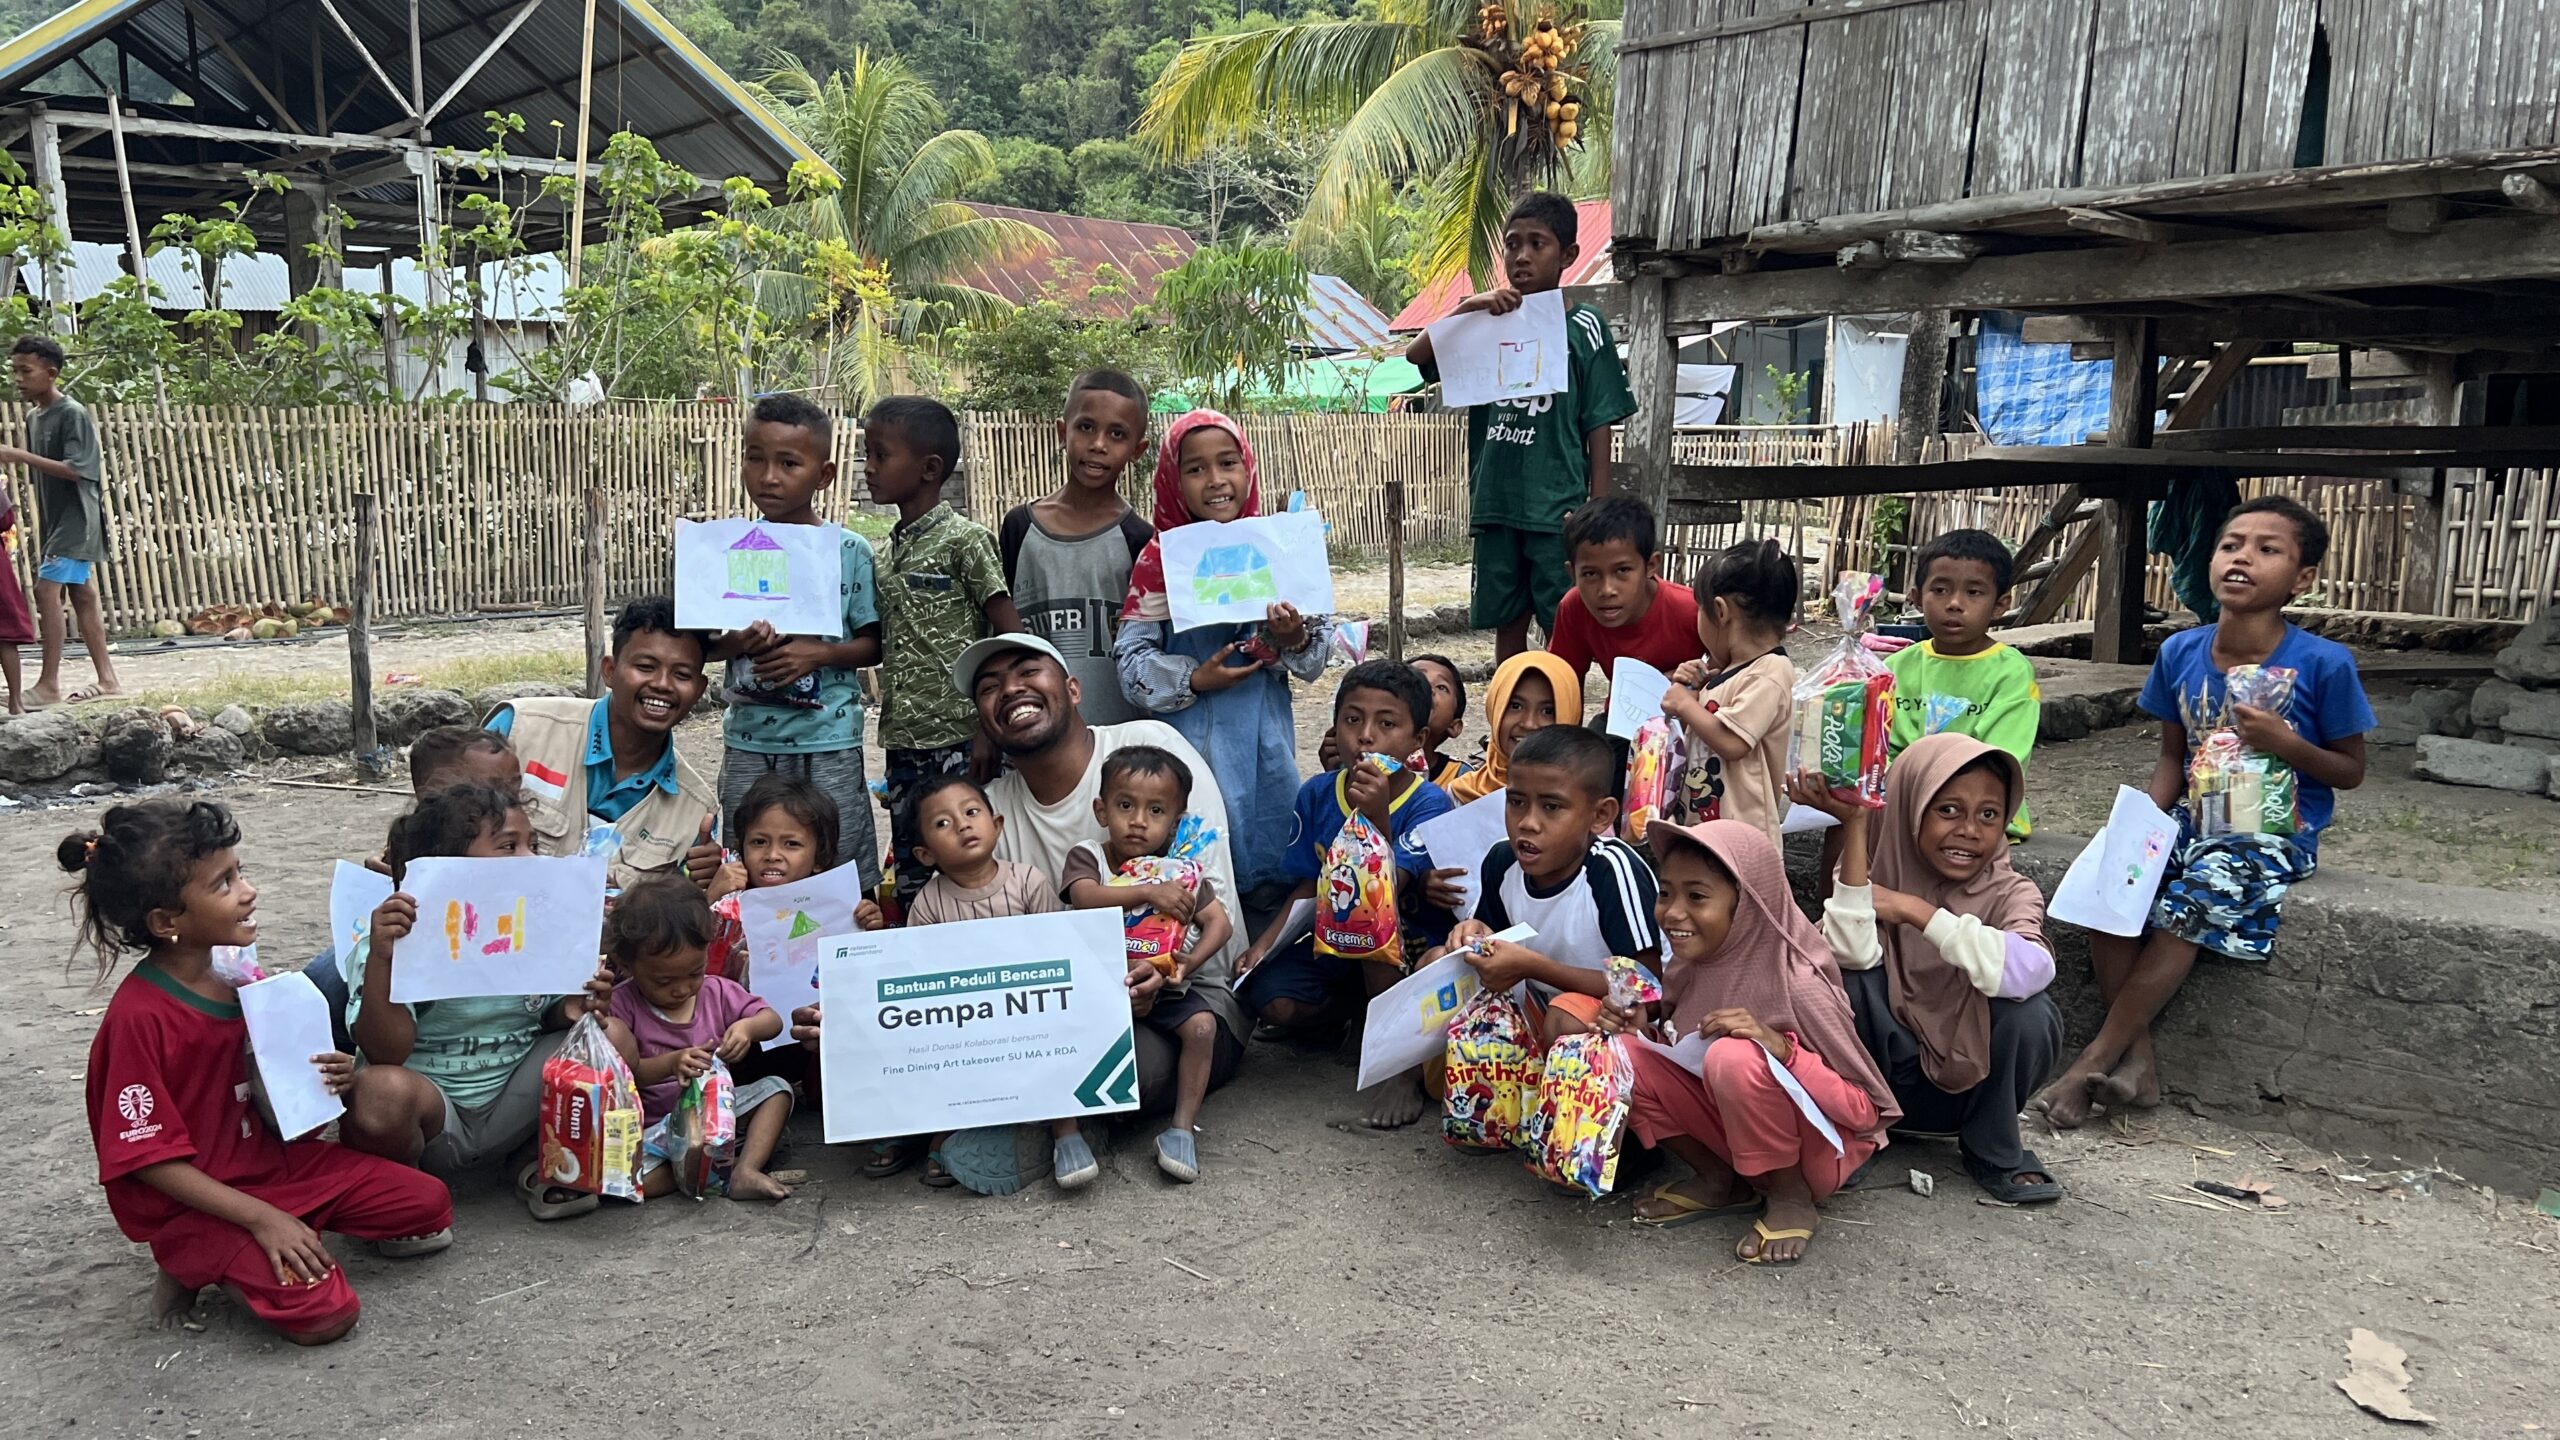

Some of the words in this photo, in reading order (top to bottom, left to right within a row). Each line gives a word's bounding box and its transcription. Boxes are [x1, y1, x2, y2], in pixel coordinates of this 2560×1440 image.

[1497, 412, 1519, 422] VISIT
[1487, 422, 1537, 446] etroit
[1868, 764, 1880, 792] Roma
[884, 980, 946, 996] Bantuan
[950, 971, 996, 989] Peduli
[1000, 967, 1065, 983] Bencana
[878, 1001, 994, 1030] Gempa
[1005, 986, 1073, 1017] NTT
[908, 1044, 930, 1054] Hasil
[932, 1040, 962, 1052] Donasi
[964, 1036, 1009, 1048] Kolaborasi
[1011, 1033, 1049, 1043] bersama
[882, 1065, 905, 1075] Fine
[907, 1062, 940, 1073] Dining
[943, 1059, 959, 1069] Art
[962, 1055, 1005, 1067] takeover
[1008, 1051, 1022, 1061] SU
[1025, 1049, 1043, 1060] MA
[1054, 1046, 1078, 1056] RDA
[1446, 1061, 1540, 1086] Birthda
[1537, 1074, 1608, 1120] irthday
[570, 1095, 585, 1139] Roma
